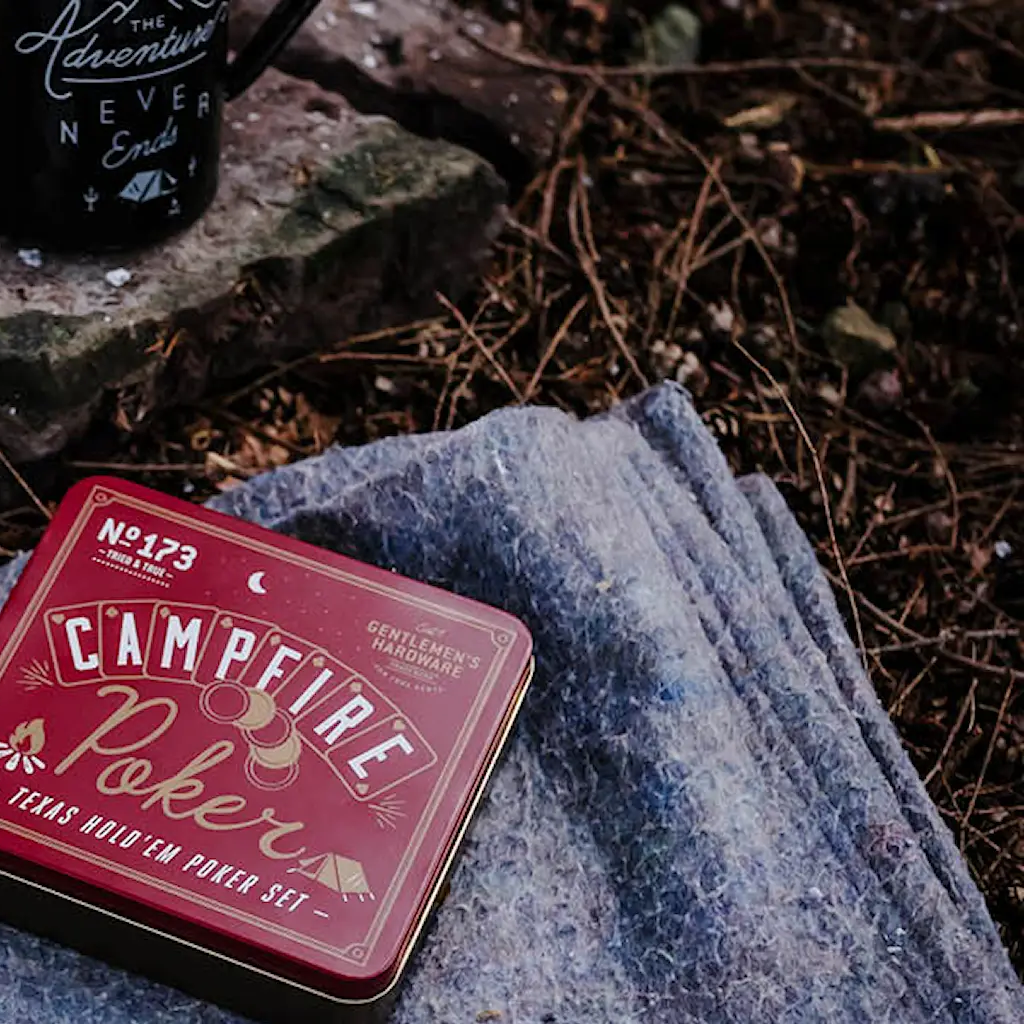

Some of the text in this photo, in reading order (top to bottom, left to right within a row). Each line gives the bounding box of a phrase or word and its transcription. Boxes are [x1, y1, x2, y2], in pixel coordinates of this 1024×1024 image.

[130, 15, 166, 33] THE
[59, 84, 210, 145] NEVER
[367, 620, 481, 669] GENTLEMEN'S
[371, 638, 464, 679] HARDWARE
[65, 611, 414, 779] CAMPFIRE
[54, 685, 306, 859] Poker
[7, 786, 311, 913] TEXAS HOLD'EM POKER SET
